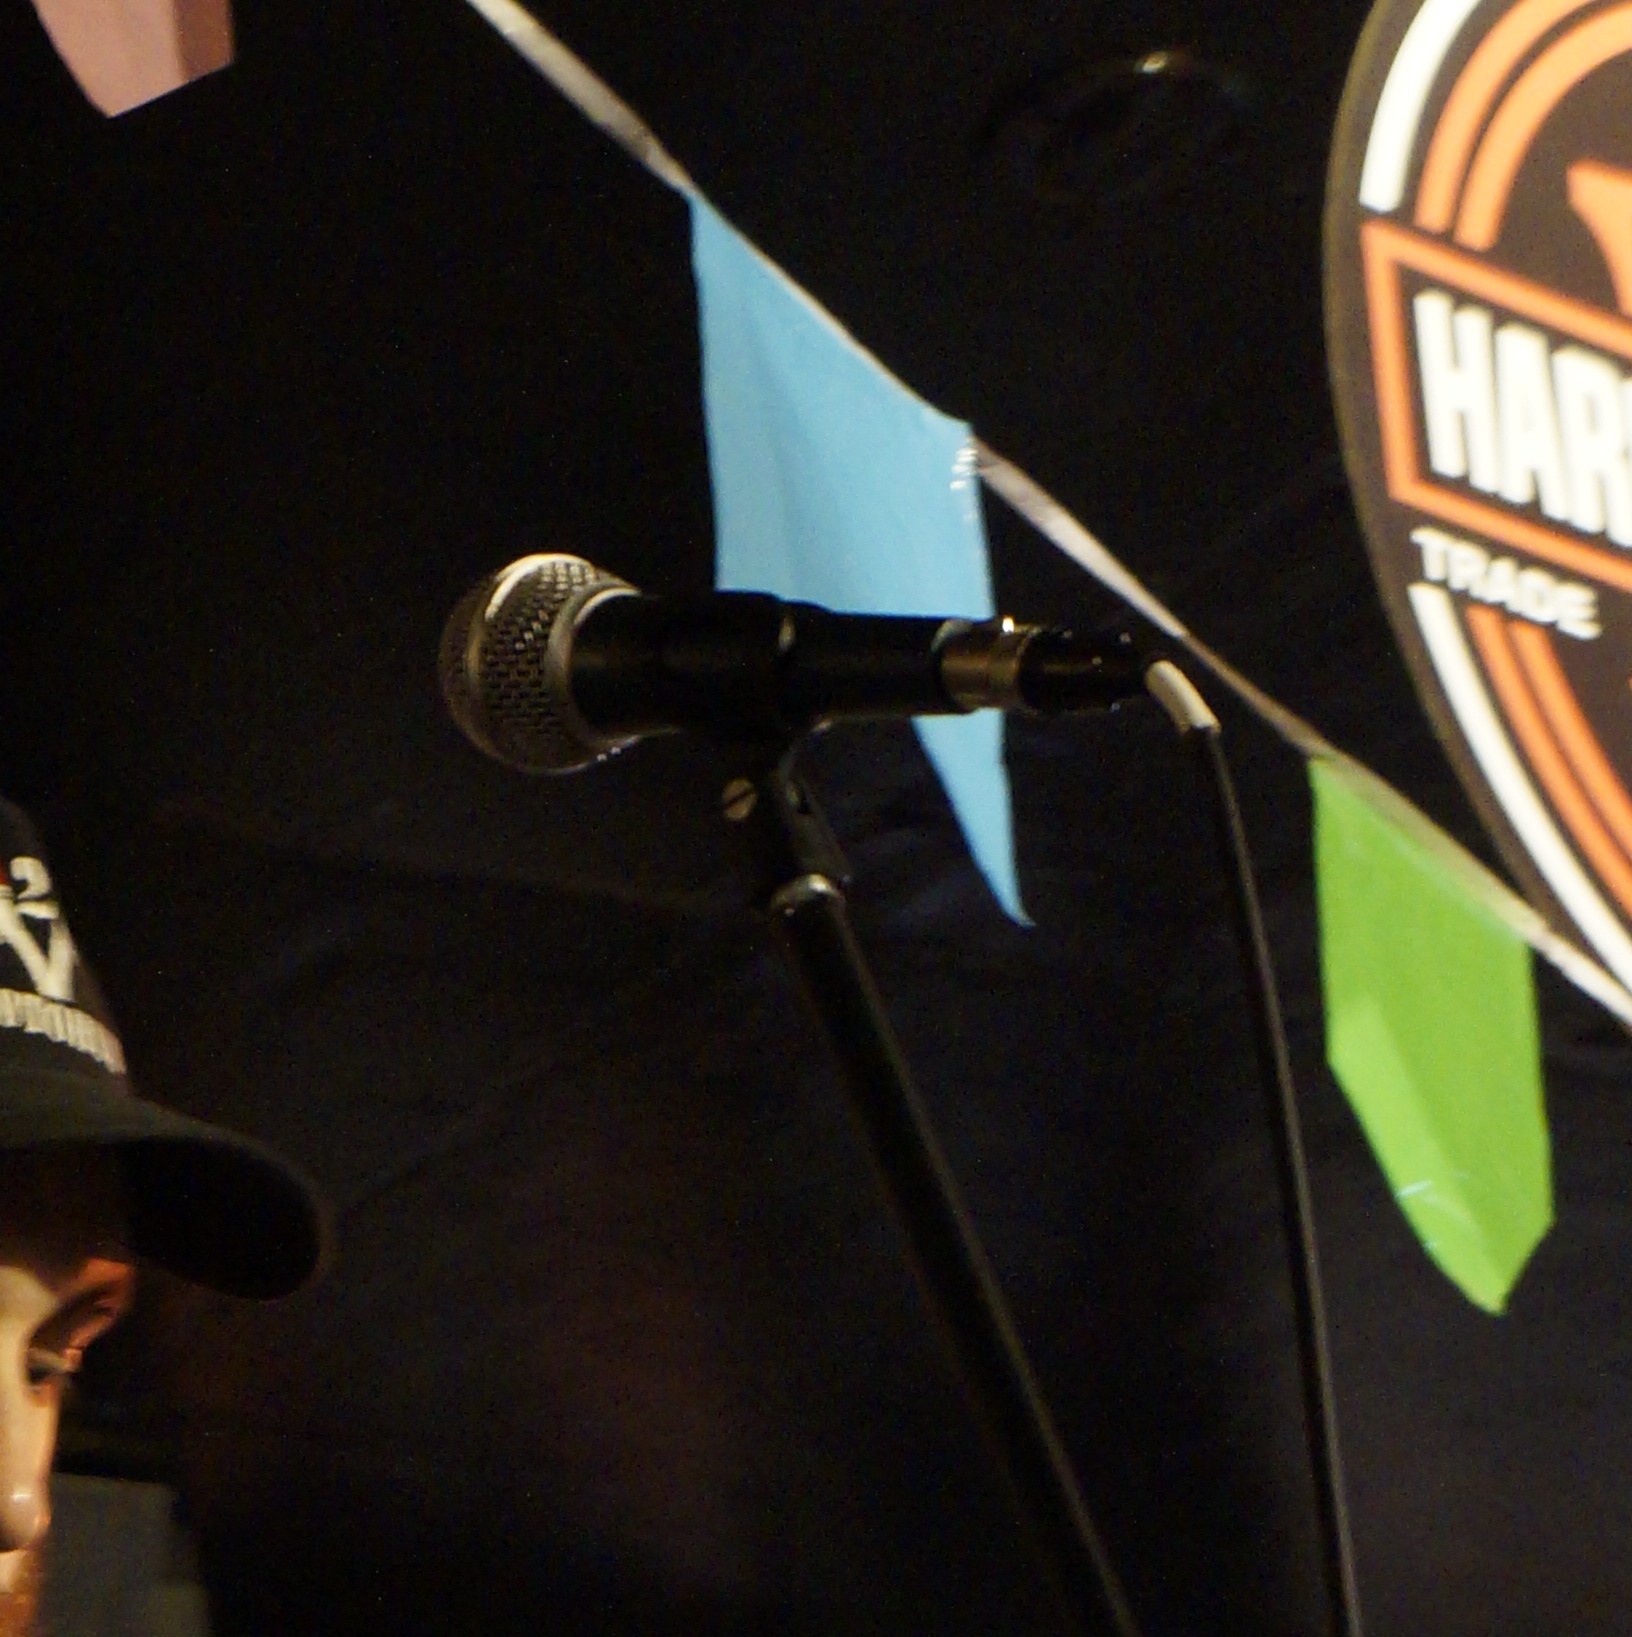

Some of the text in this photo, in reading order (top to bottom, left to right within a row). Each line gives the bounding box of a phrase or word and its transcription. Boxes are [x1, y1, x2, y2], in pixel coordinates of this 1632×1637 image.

[1413, 286, 1632, 549] HAR
[1409, 525, 1603, 641] TRADE
[10, 855, 59, 920] 2
